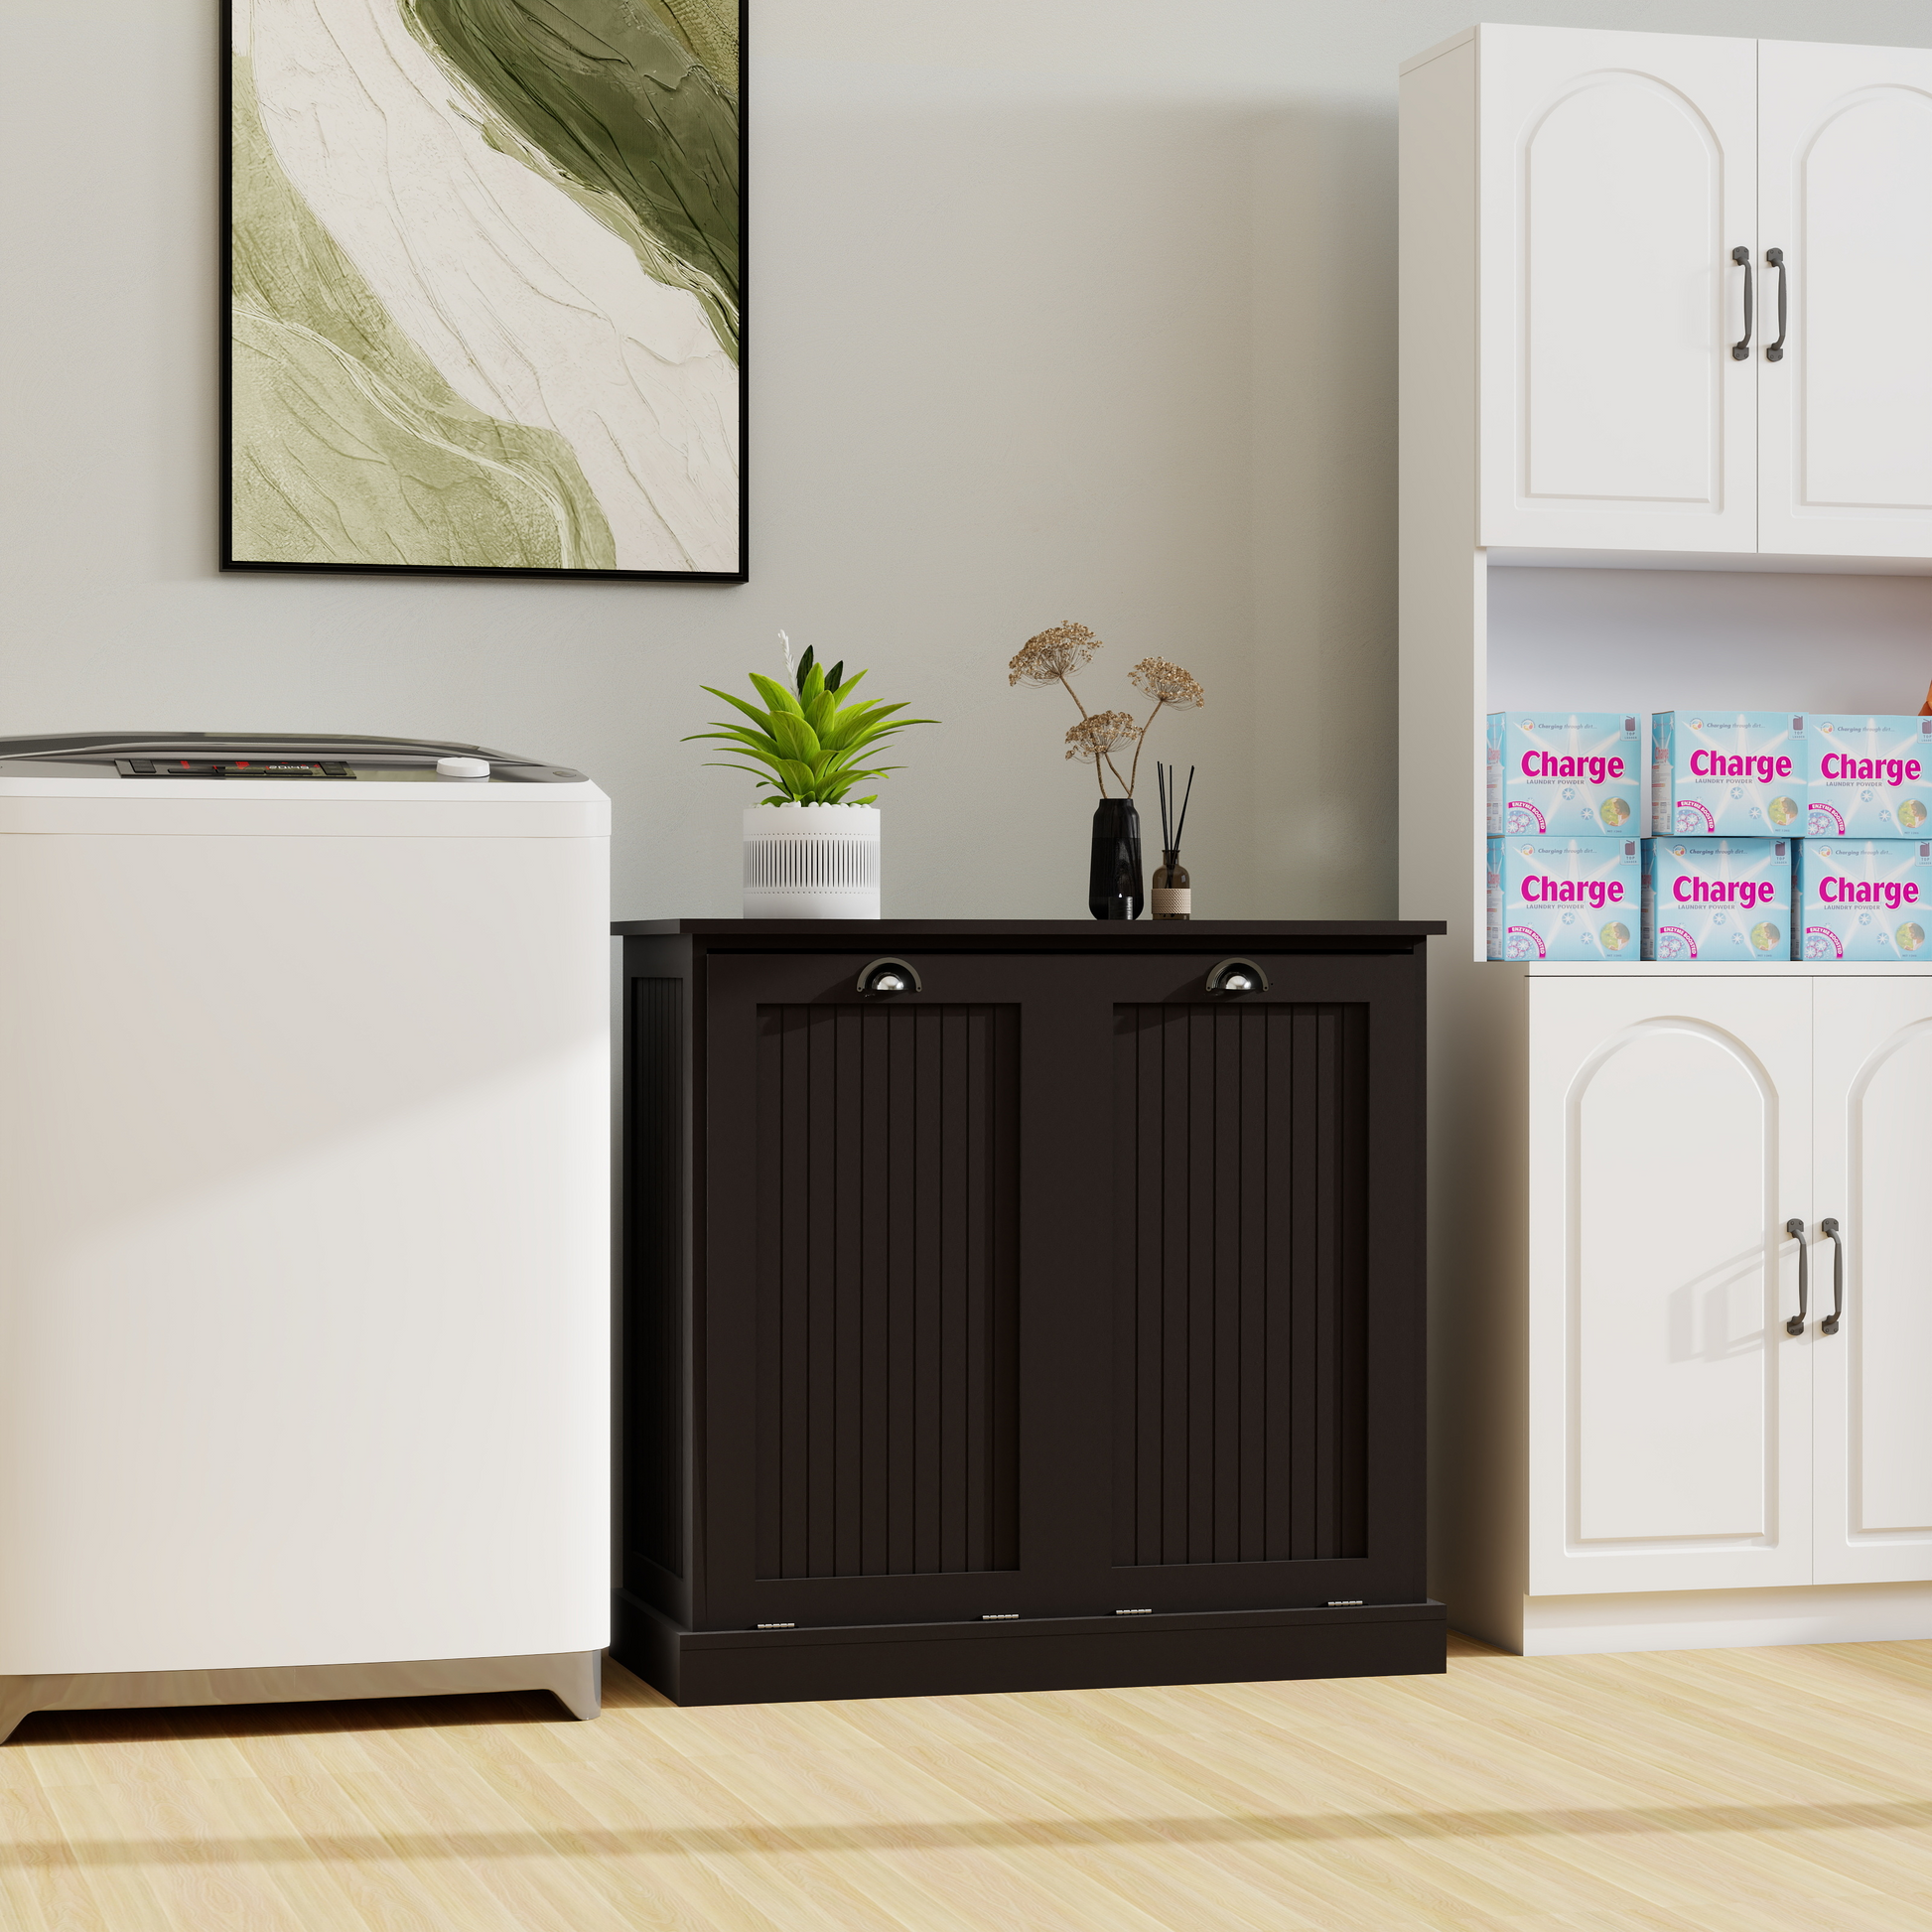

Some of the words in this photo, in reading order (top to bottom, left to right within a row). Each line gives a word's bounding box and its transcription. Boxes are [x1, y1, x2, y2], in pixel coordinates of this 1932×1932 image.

[1521, 751, 1624, 784] Charge
[1690, 750, 1792, 783] Charge
[1821, 753, 1921, 786] Charge
[1532, 808, 1545, 830] BOOSTED
[1701, 807, 1714, 829] BOOSTED
[1831, 810, 1844, 831] BOOSTED
[1521, 876, 1624, 908] Charge
[1673, 876, 1774, 909] Charge
[1819, 876, 1918, 909] Charge
[1532, 932, 1545, 954] BOOSTED
[1683, 933, 1696, 954] BOOSTED
[1829, 933, 1843, 955] BOOSTED
